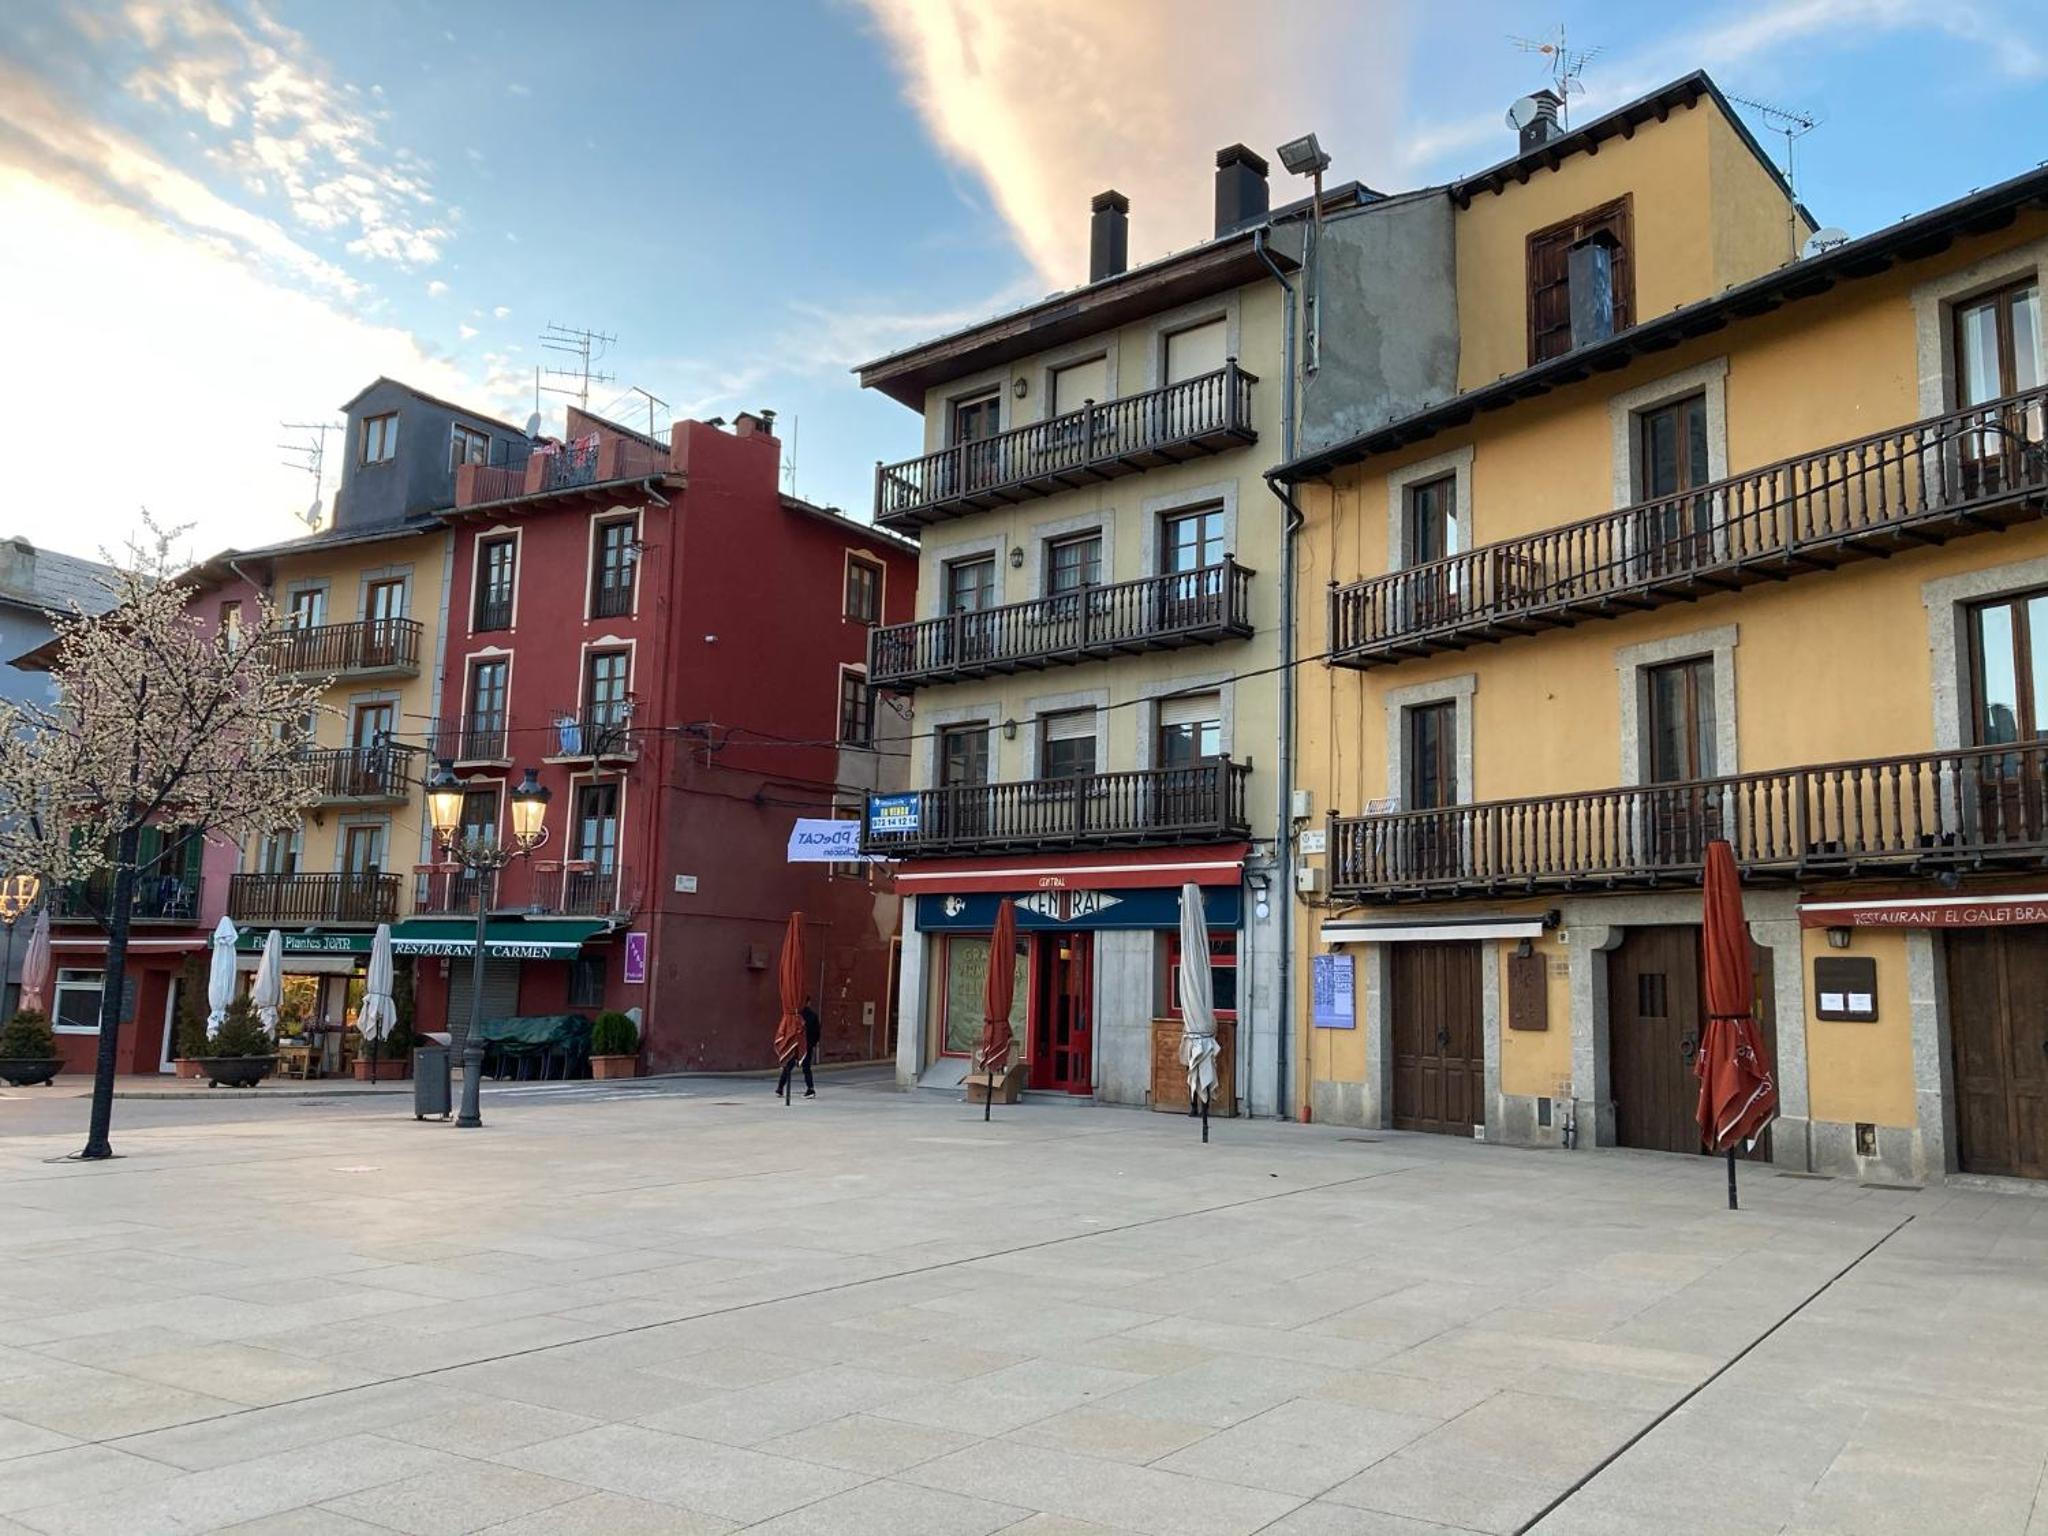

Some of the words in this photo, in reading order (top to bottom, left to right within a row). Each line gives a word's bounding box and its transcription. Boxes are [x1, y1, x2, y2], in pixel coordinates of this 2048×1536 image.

[1853, 911, 1937, 925] RESTAURANT
[1945, 910, 1960, 922] EL
[1963, 908, 2011, 923] GALET
[2015, 907, 2048, 920] BRA
[395, 943, 477, 955] RESTAURAN
[492, 945, 551, 958] CARMEN
